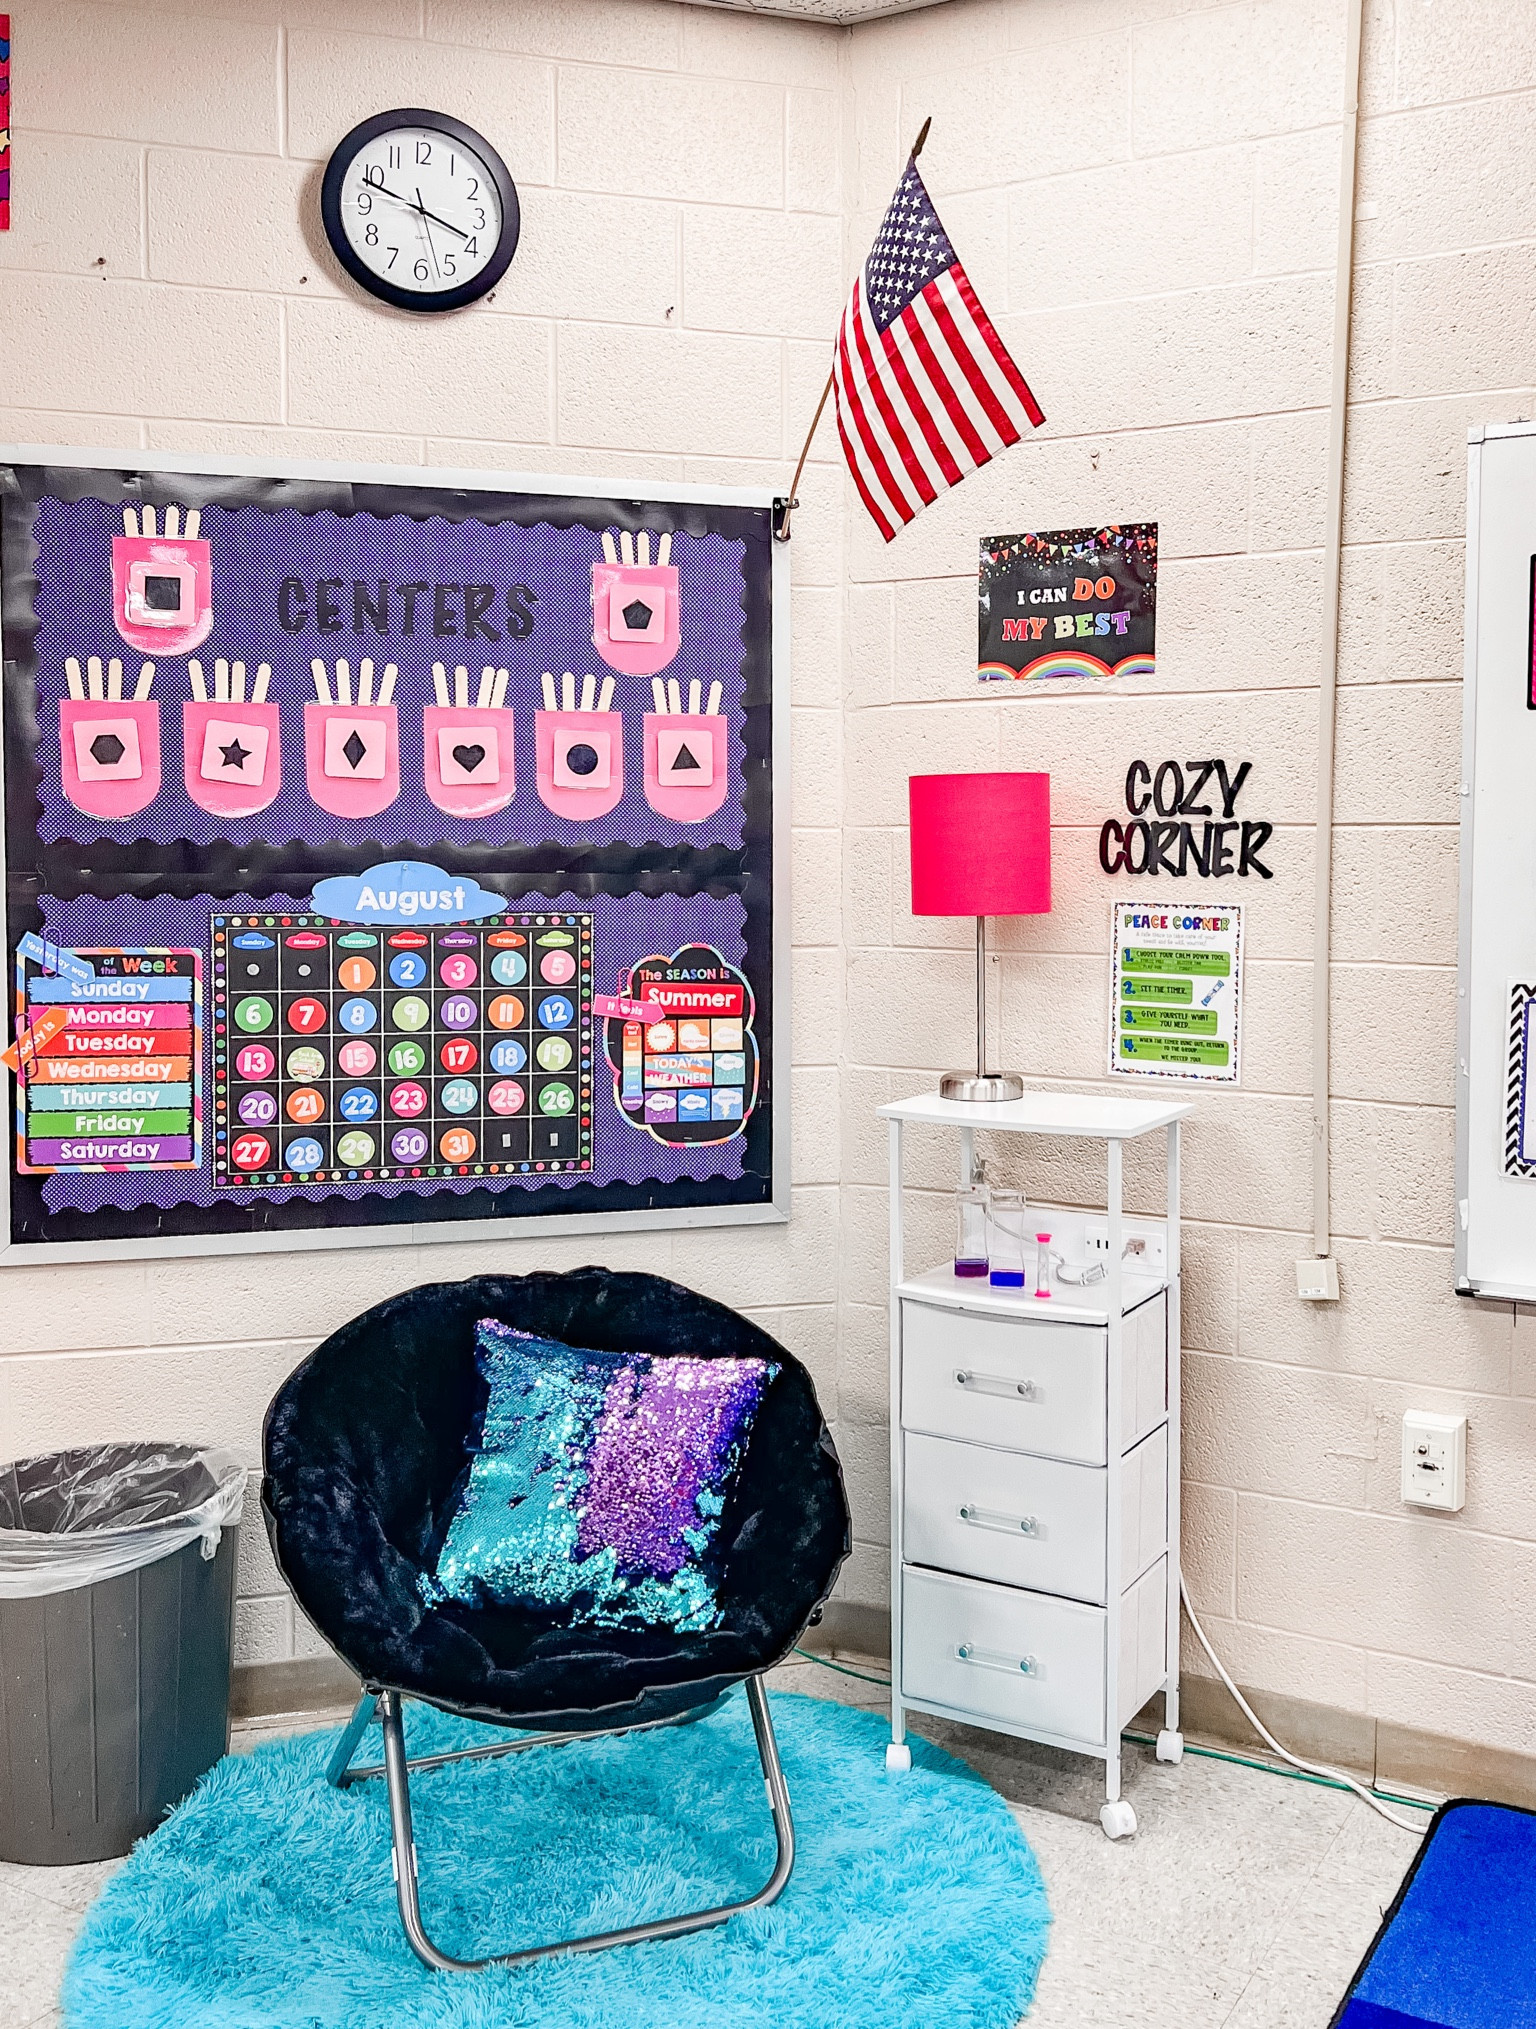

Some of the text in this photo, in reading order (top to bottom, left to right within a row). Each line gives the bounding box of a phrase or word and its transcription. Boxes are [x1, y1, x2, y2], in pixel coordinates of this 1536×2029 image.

[389, 145, 401, 169] 11
[416, 141, 432, 165] 12
[365, 164, 385, 187] 10
[466, 177, 479, 201] 2
[357, 192, 373, 216] 9
[472, 208, 486, 230] 3
[365, 223, 379, 246] 8
[463, 236, 479, 258] 4
[386, 247, 399, 270] 7
[413, 258, 429, 281] 6
[443, 254, 456, 276] 5
[1016, 575, 1116, 606] I CAN DO
[278, 577, 539, 641] CENTERS
[1002, 610, 1131, 641] MY BEST
[1125, 758, 1253, 818] COZY
[1099, 818, 1274, 880] CORNER
[355, 885, 466, 916] August
[1124, 913, 1230, 931] PEACE CORNER
[241, 937, 266, 947] Sunday
[293, 938, 320, 947] Monday
[343, 938, 371, 946] Tuesday
[391, 937, 426, 946] Wednesday
[444, 937, 474, 946] Thursday
[496, 937, 517, 945] Friday
[71, 965, 89, 980] was
[101, 956, 179, 975] of the Week
[353, 956, 567, 984] 1 2 3 4 5
[639, 968, 730, 981] The SEASON is
[70, 982, 150, 999] Sunday
[648, 988, 736, 1008] Summer
[1123, 981, 1136, 994] 2.
[68, 1007, 154, 1027] Monday
[245, 1001, 567, 1026] 6 7 8 9 10 11 12
[607, 1001, 615, 1011] It
[1124, 1009, 1137, 1023] 3.
[1141, 1010, 1157, 1018] GIVE
[1159, 1011, 1188, 1019] YOURSELF
[1160, 1020, 1172, 1028] YOU
[65, 1035, 156, 1052] Tuesday
[1124, 1038, 1137, 1052] 4.
[243, 1051, 267, 1073] 13
[345, 1047, 369, 1069] 15
[395, 1047, 418, 1070] 16
[447, 1045, 470, 1067] 17
[497, 1047, 518, 1067] 18
[543, 1043, 566, 1065] 19
[653, 1057, 704, 1070] TODAY'S
[47, 1061, 173, 1080] Wednesday
[649, 1072, 707, 1085] WEATHER
[60, 1087, 160, 1106] Thursday
[241, 1086, 571, 1120] 20 21 22 23 24 25 26
[75, 1114, 145, 1134] Friday
[60, 1142, 161, 1161] Saturday
[236, 1134, 470, 1167] 27 28 29 30 31
